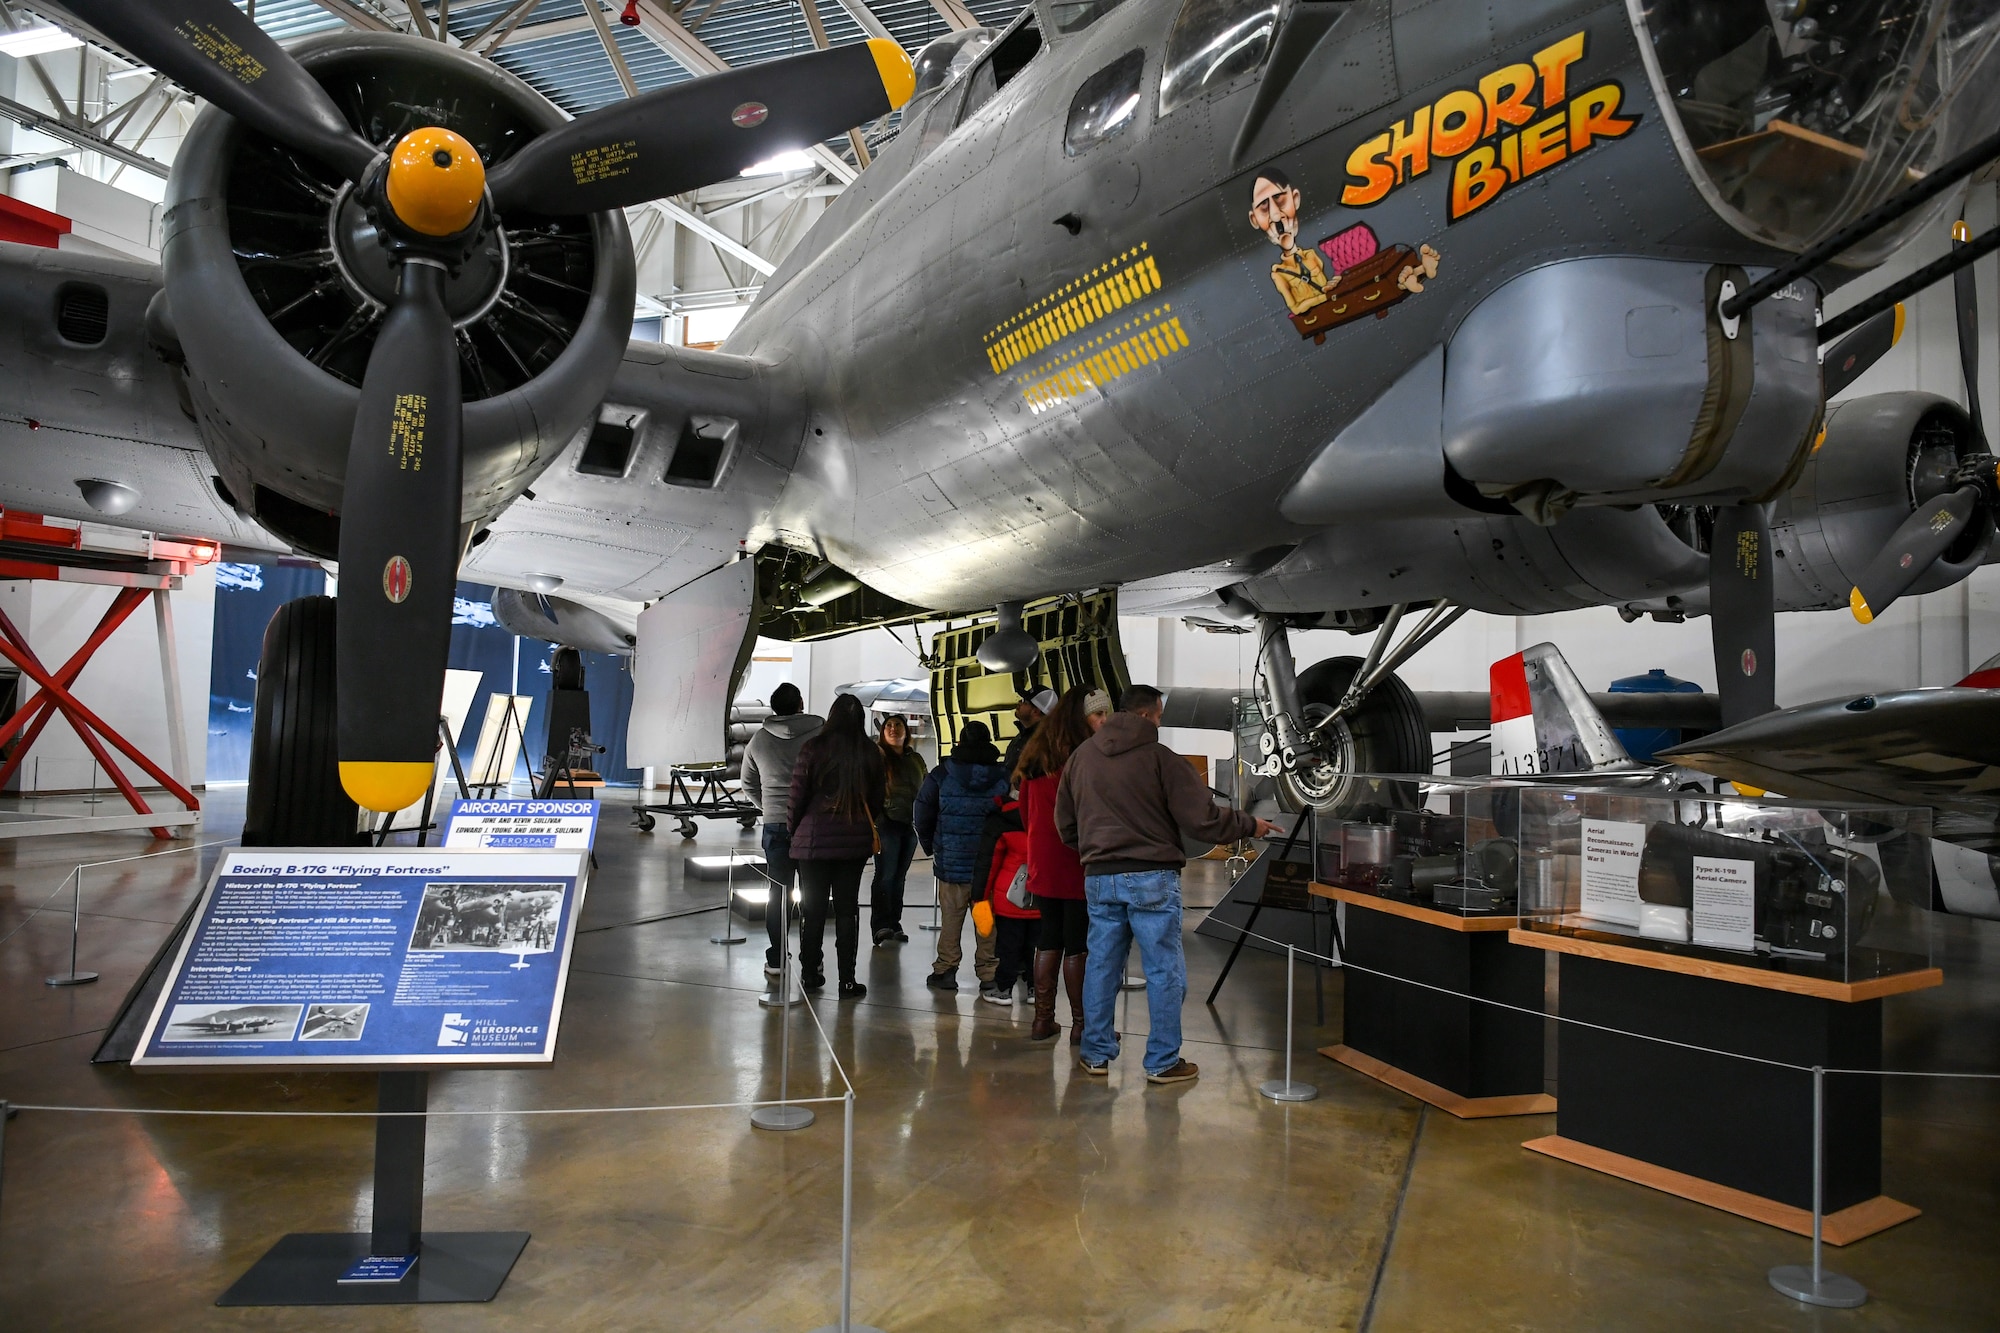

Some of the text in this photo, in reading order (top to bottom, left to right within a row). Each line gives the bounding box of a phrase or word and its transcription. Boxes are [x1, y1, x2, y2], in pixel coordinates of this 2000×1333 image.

[1340, 30, 1585, 207] SHORT
[1449, 83, 1641, 222] BIER
[458, 803, 593, 814] AIRCRAFT SPONSOR
[1587, 837, 1634, 847] Reconnaissance
[232, 865, 282, 877] Boeing
[332, 865, 381, 877] “Flying
[386, 866, 450, 874] Fortress”
